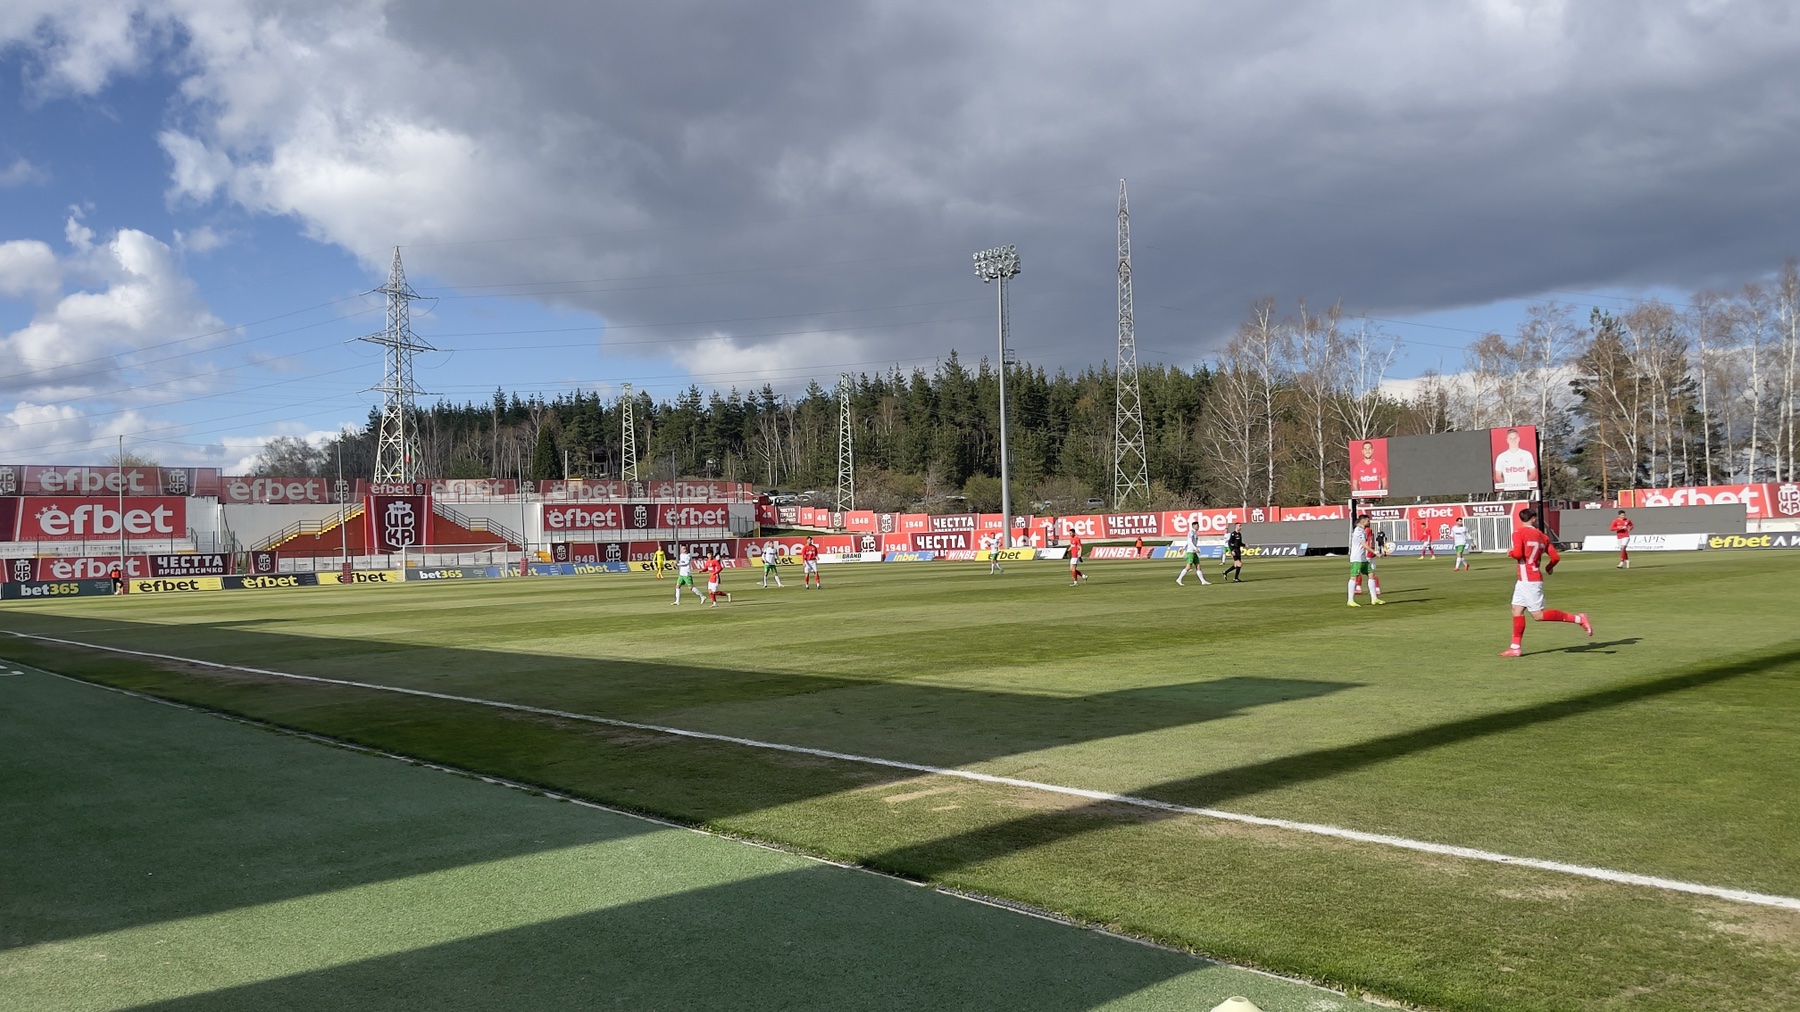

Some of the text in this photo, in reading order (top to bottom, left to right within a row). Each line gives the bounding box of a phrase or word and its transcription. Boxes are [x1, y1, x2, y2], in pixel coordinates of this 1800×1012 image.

[40, 468, 144, 491] efbet
[230, 479, 319, 500] efbet
[371, 483, 410, 494] efbet
[549, 509, 617, 527] efbet
[665, 508, 726, 525] efbet
[1418, 507, 1453, 518] efbet
[40, 504, 173, 535] efbet
[933, 517, 974, 528] ЧЕСТТА
[1108, 515, 1157, 528] ЧЕСТТА
[1173, 511, 1237, 532] efbet
[917, 535, 966, 549] ЧЕСТТА
[1633, 535, 1666, 544] LAPIS
[1709, 535, 1772, 548] efbet
[668, 543, 730, 557] ЧСТТА
[886, 543, 907, 551] 1948
[1262, 547, 1298, 556] ЛИГА
[893, 551, 920, 561] inbet
[949, 550, 977, 560] WINBE
[157, 556, 223, 568] ЧЕСТТА
[419, 570, 463, 579] bet365
[573, 564, 609, 574] inbet
[139, 579, 200, 592] efbet
[242, 575, 299, 588] efbet
[21, 583, 79, 596] bet365
